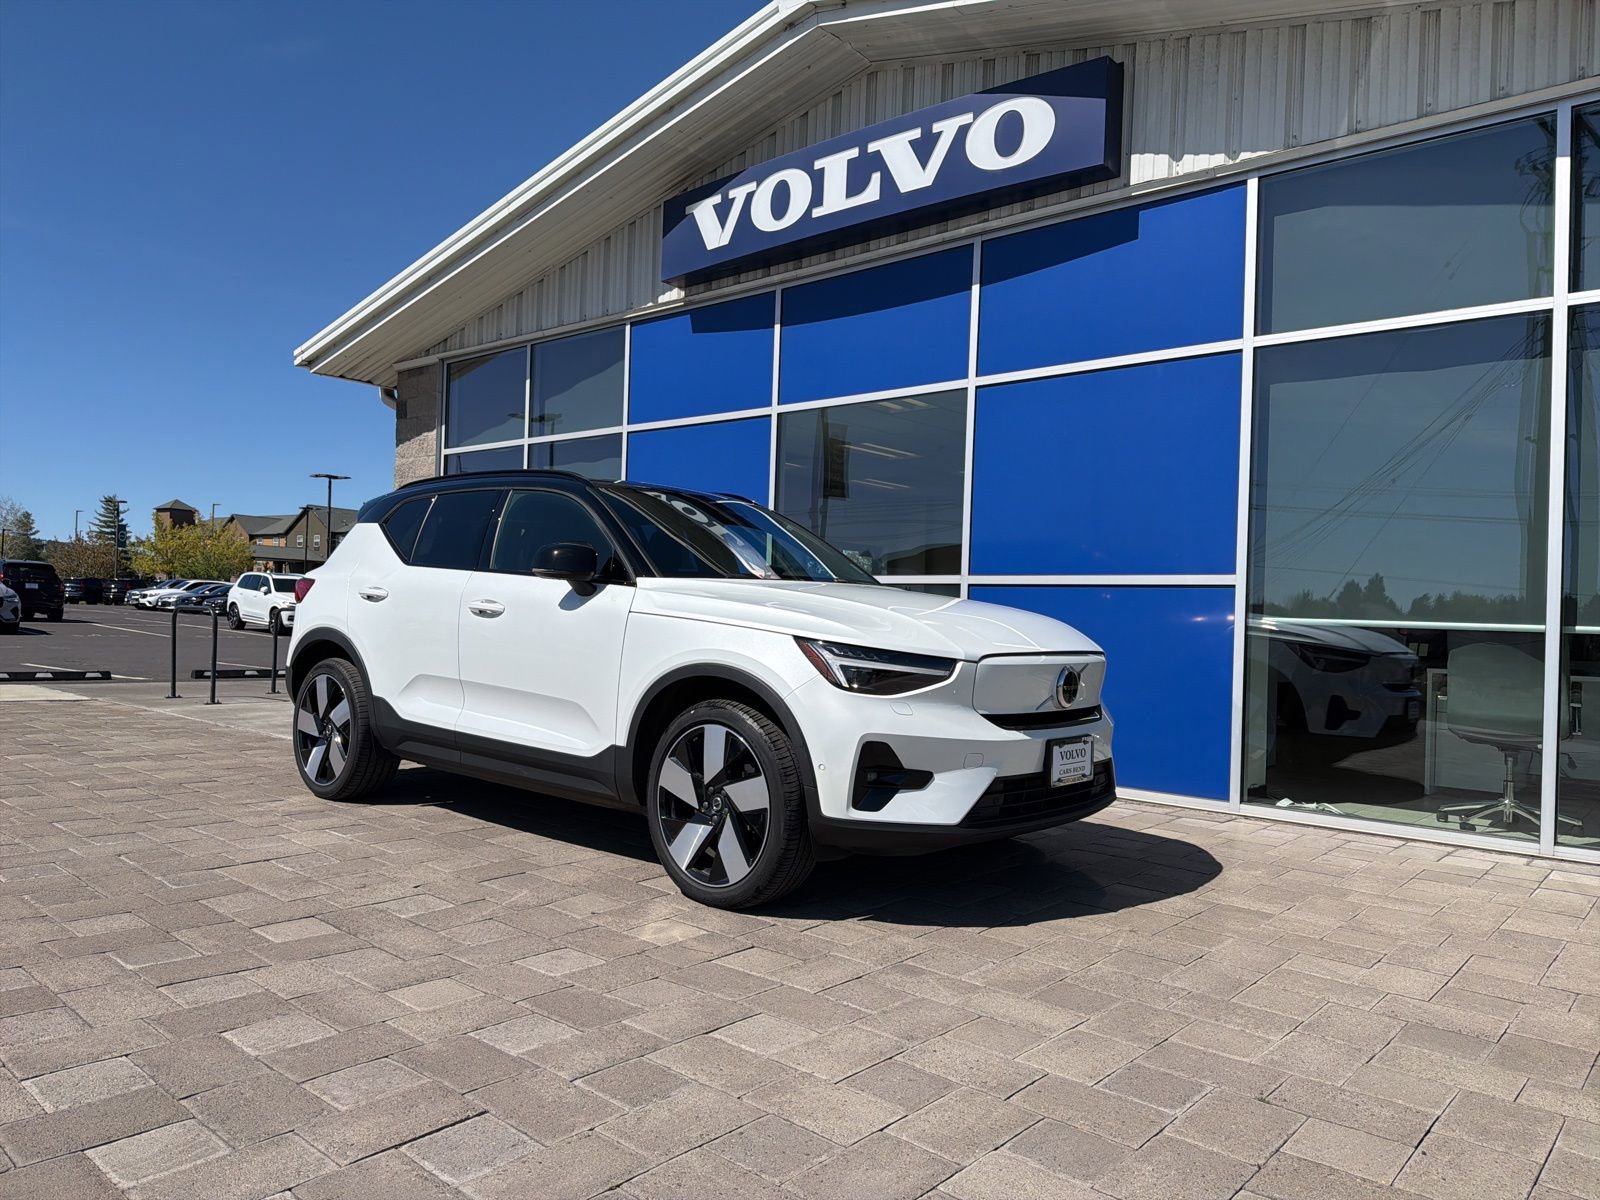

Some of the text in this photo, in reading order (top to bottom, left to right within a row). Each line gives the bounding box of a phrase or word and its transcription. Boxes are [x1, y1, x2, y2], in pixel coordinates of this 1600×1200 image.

[685, 96, 1056, 251] VOLVO
[1059, 747, 1086, 761] VOLVO
[1058, 767, 1072, 776] CARS
